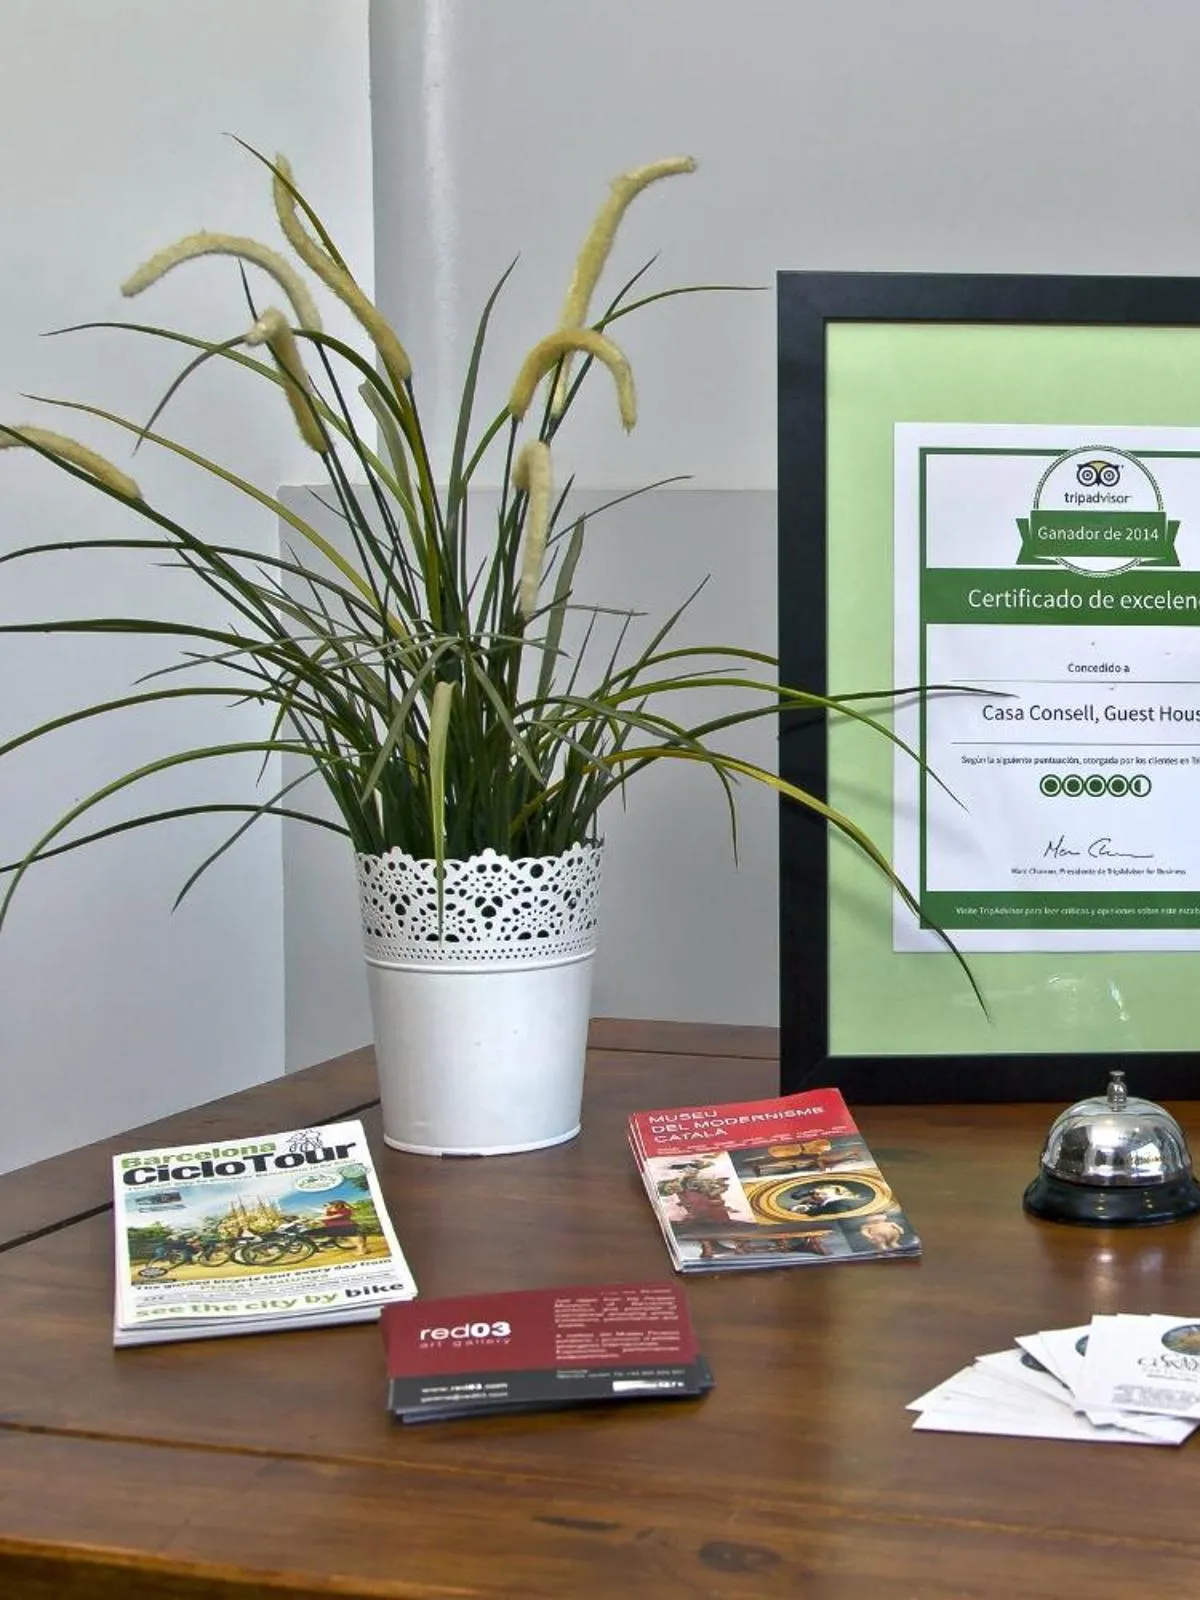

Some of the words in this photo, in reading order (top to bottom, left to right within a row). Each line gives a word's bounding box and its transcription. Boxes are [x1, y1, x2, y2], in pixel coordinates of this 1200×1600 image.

[1064, 491, 1129, 506] tripadvisor
[1038, 525, 1101, 541] Ganador
[1104, 526, 1122, 541] de
[1125, 527, 1159, 542] 2014
[968, 588, 1083, 609] Certificado
[1088, 589, 1114, 609] de
[1067, 663, 1121, 674] Concedido
[1122, 665, 1130, 674] a
[983, 704, 1025, 722] Casa
[1029, 704, 1100, 724] Consell,
[1103, 705, 1155, 723] Guest
[961, 755, 986, 767] Según
[986, 756, 995, 764] la
[996, 756, 1032, 766] siguiente
[1033, 756, 1082, 767] puntuación,
[1083, 757, 1119, 767] otorgada
[1119, 758, 1134, 767] por
[1135, 756, 1147, 765] los
[1149, 756, 1179, 765] clientes
[956, 906, 979, 915] Visite
[979, 906, 1024, 917] TripAdvisor
[1025, 908, 1043, 917] para
[1044, 907, 1060, 915] leer
[1090, 908, 1097, 917] y
[1097, 907, 1136, 917] opiniones
[1137, 907, 1159, 916] sobre
[1160, 908, 1178, 916] este
[650, 1109, 718, 1124] MUSEU
[652, 1123, 690, 1134] DEL
[694, 1106, 825, 1130] MODERNISME
[121, 1140, 277, 1170] Barcelona
[122, 1142, 357, 1187] CicloTour
[163, 1279, 211, 1290] guided
[213, 1276, 261, 1286] bicycle
[263, 1272, 292, 1281] tour
[295, 1267, 330, 1279] every
[333, 1263, 358, 1272] day
[359, 1258, 392, 1267] from
[136, 1306, 187, 1318] see
[190, 1300, 238, 1313] the
[245, 1296, 298, 1311] city
[304, 1290, 339, 1304] by
[345, 1281, 404, 1299] bike
[420, 1320, 512, 1340] red03
[419, 1341, 443, 1349] art
[452, 1337, 512, 1348] gallery
